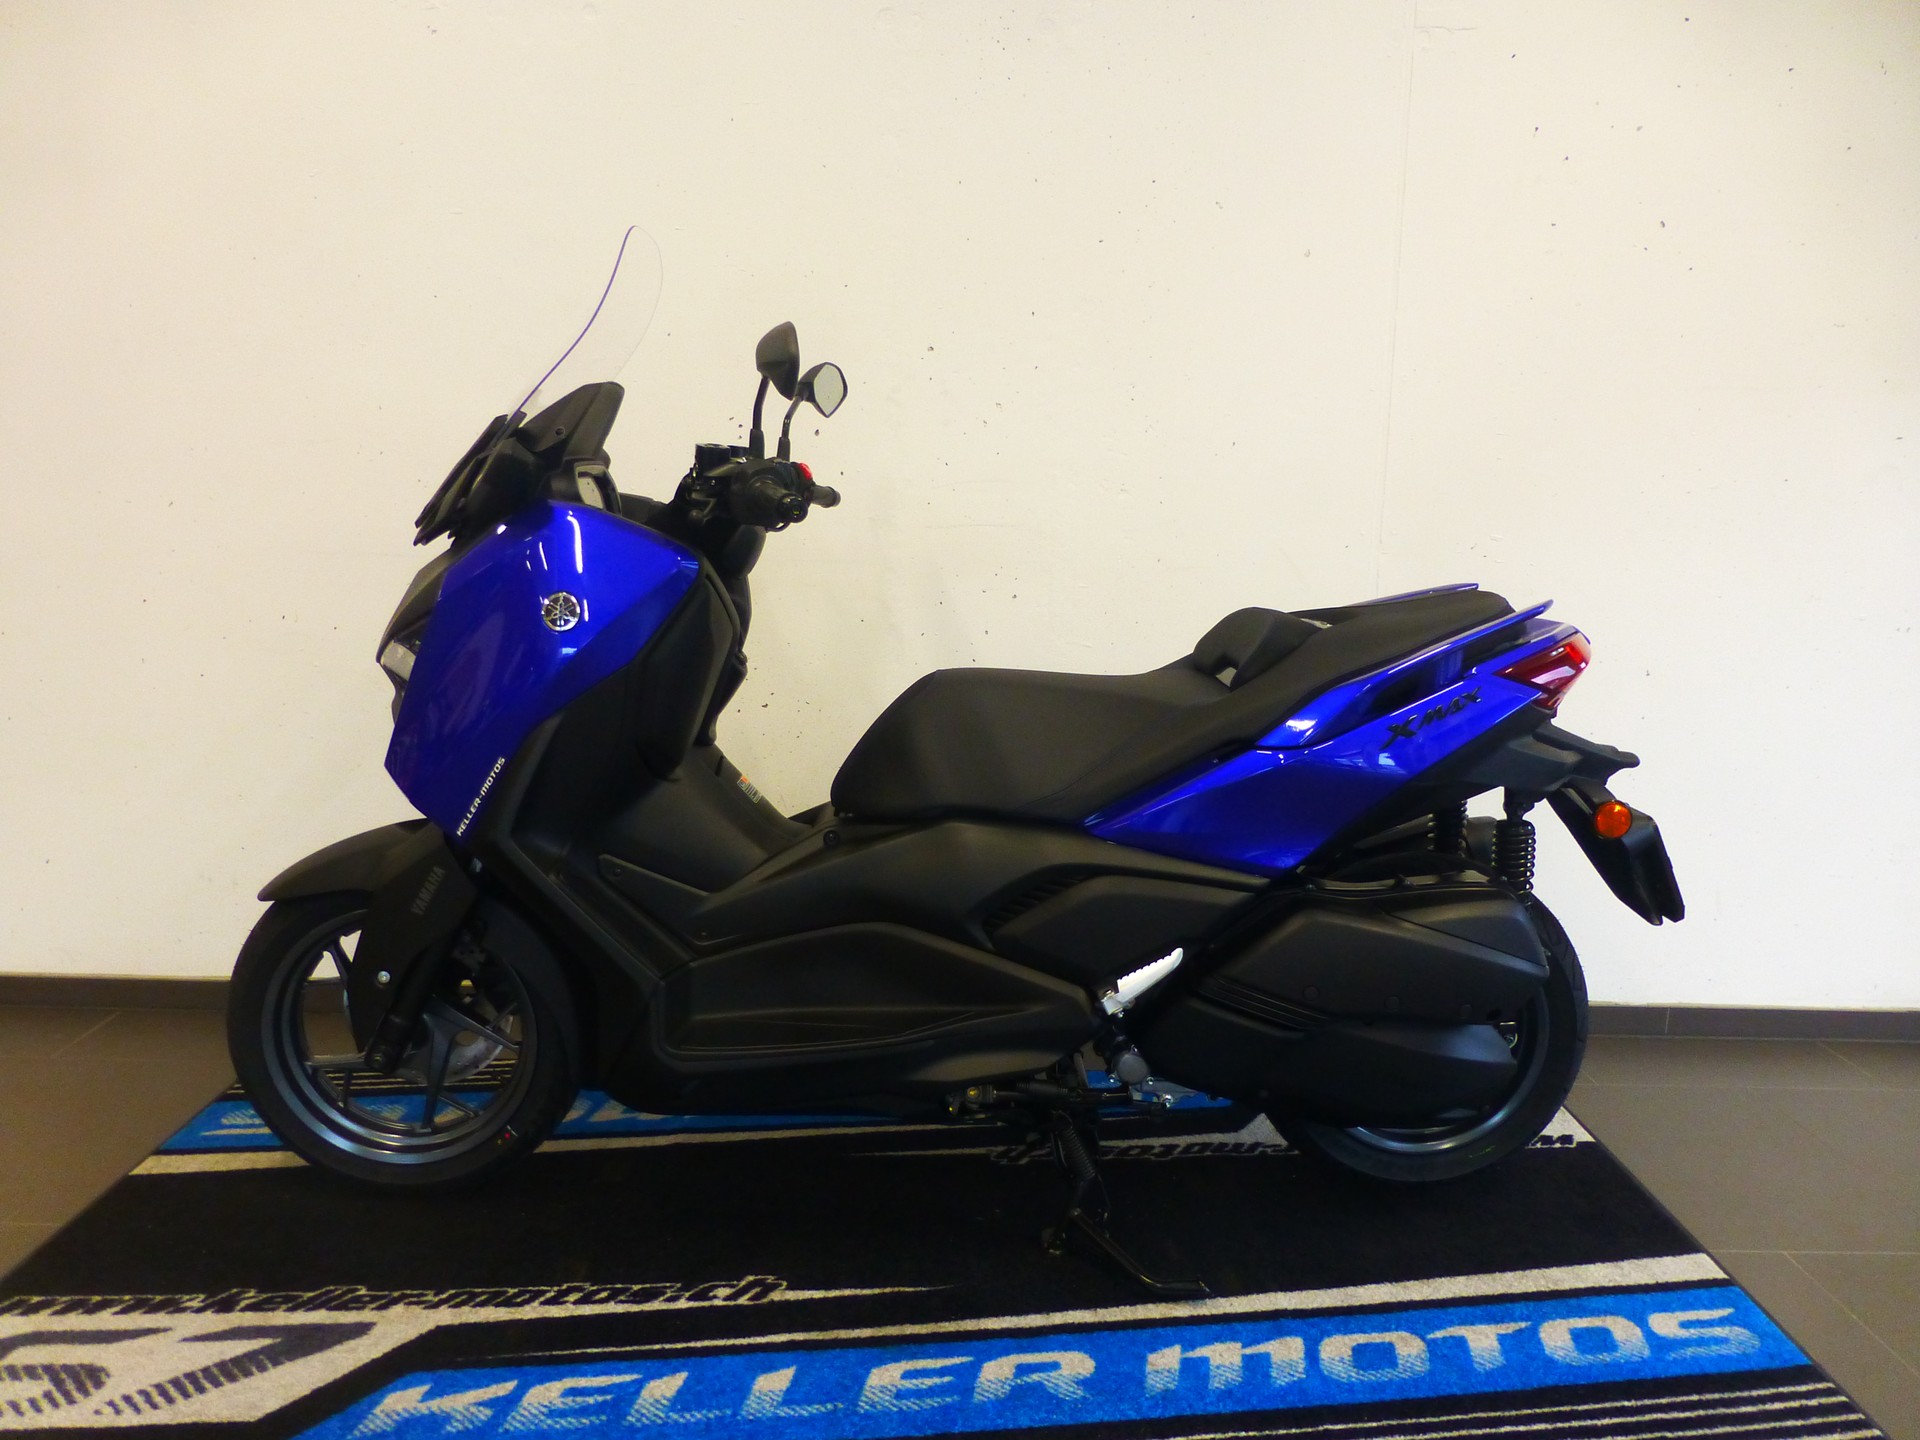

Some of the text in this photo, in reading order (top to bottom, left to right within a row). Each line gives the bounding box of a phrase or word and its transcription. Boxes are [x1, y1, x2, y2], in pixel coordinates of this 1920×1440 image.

[456, 757, 505, 837] KELLER-MOTOS
[410, 865, 446, 916] YAMAHA
[344, 1350, 1097, 1439] KELLER
[1144, 1308, 1762, 1396] MOTOS
